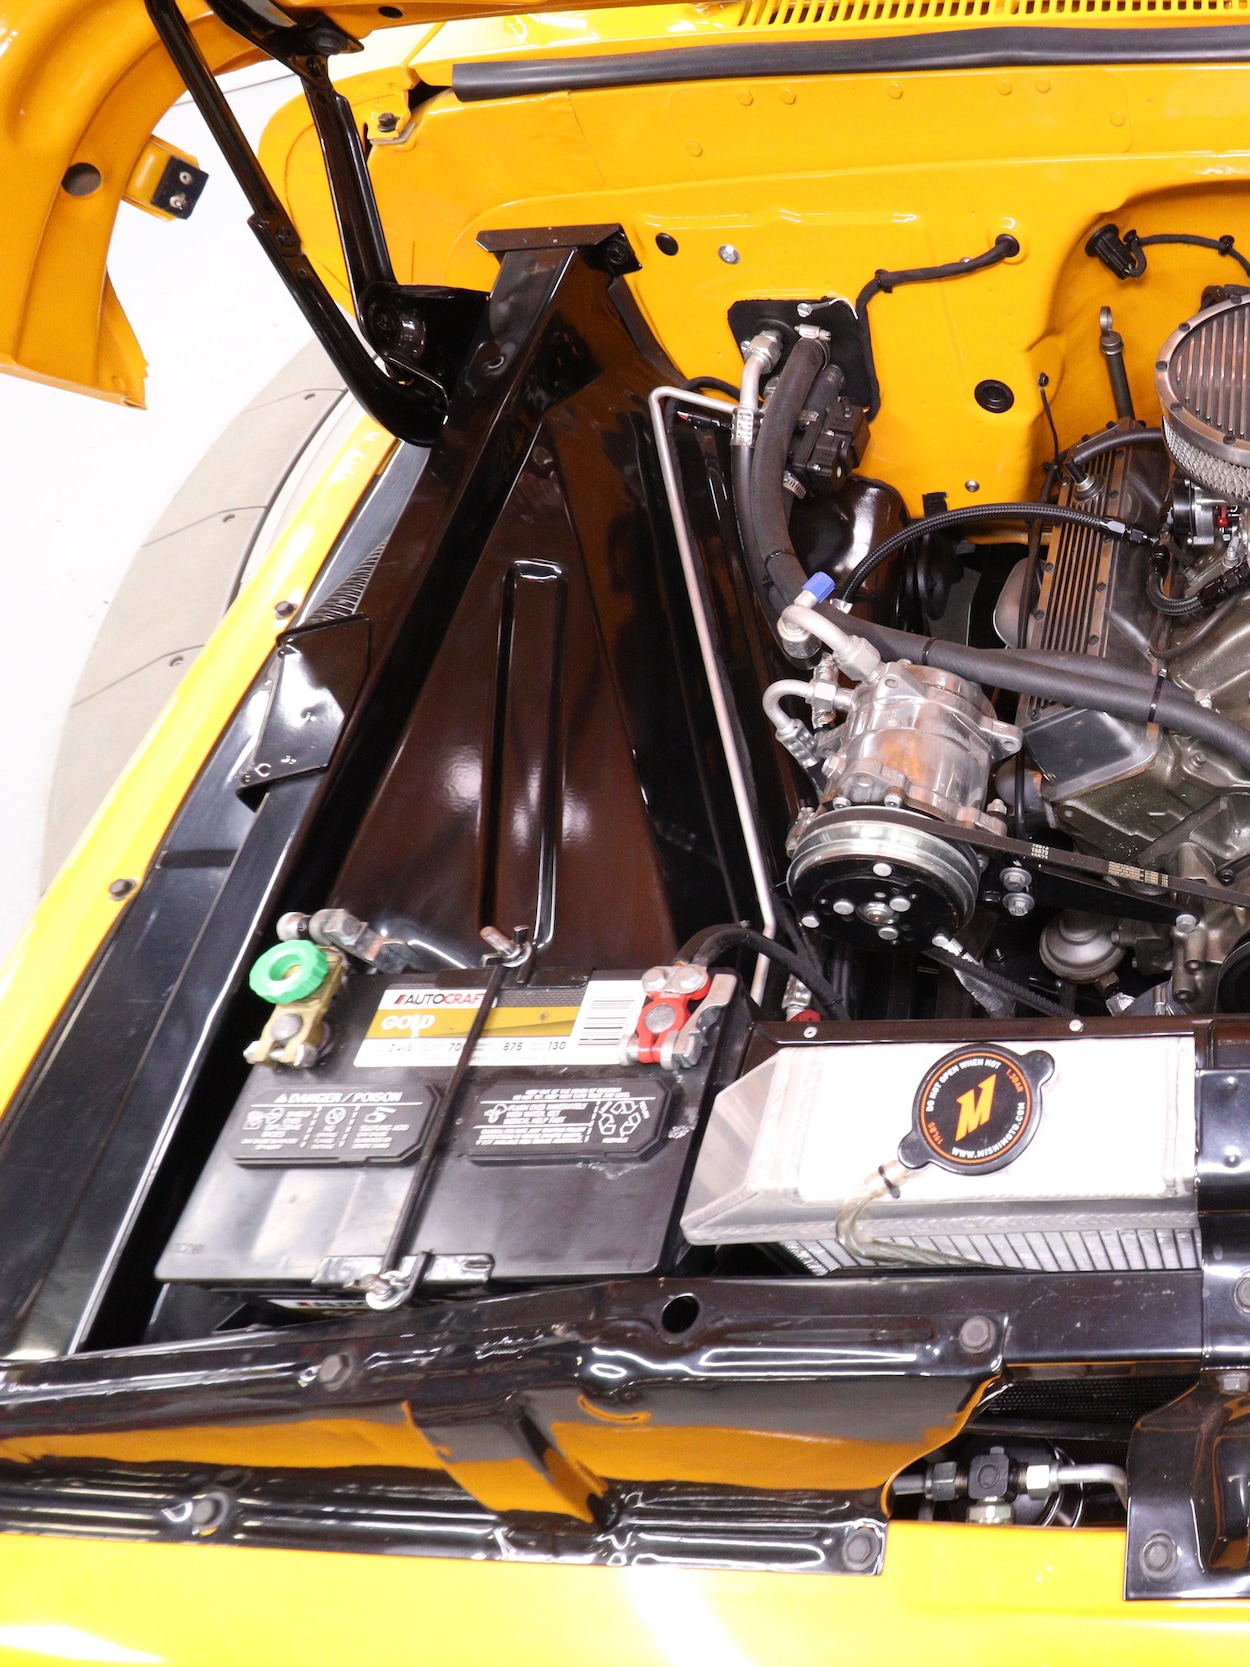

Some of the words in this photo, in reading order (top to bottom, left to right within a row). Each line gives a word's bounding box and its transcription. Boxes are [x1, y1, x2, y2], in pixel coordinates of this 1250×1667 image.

[380, 1014, 436, 1030] GOLD
[503, 1042, 523, 1051] 875
[548, 1041, 567, 1050] 130
[959, 1058, 984, 1070] WHEN
[984, 1059, 1002, 1070] HOT
[939, 1065, 960, 1084] OPEN
[287, 1093, 343, 1104] DANGER
[352, 1091, 403, 1103] POISON
[928, 1082, 942, 1100] NOT
[925, 1100, 935, 1112] DO
[951, 1102, 1026, 1159] WWW.MISHIMOTO.COM
